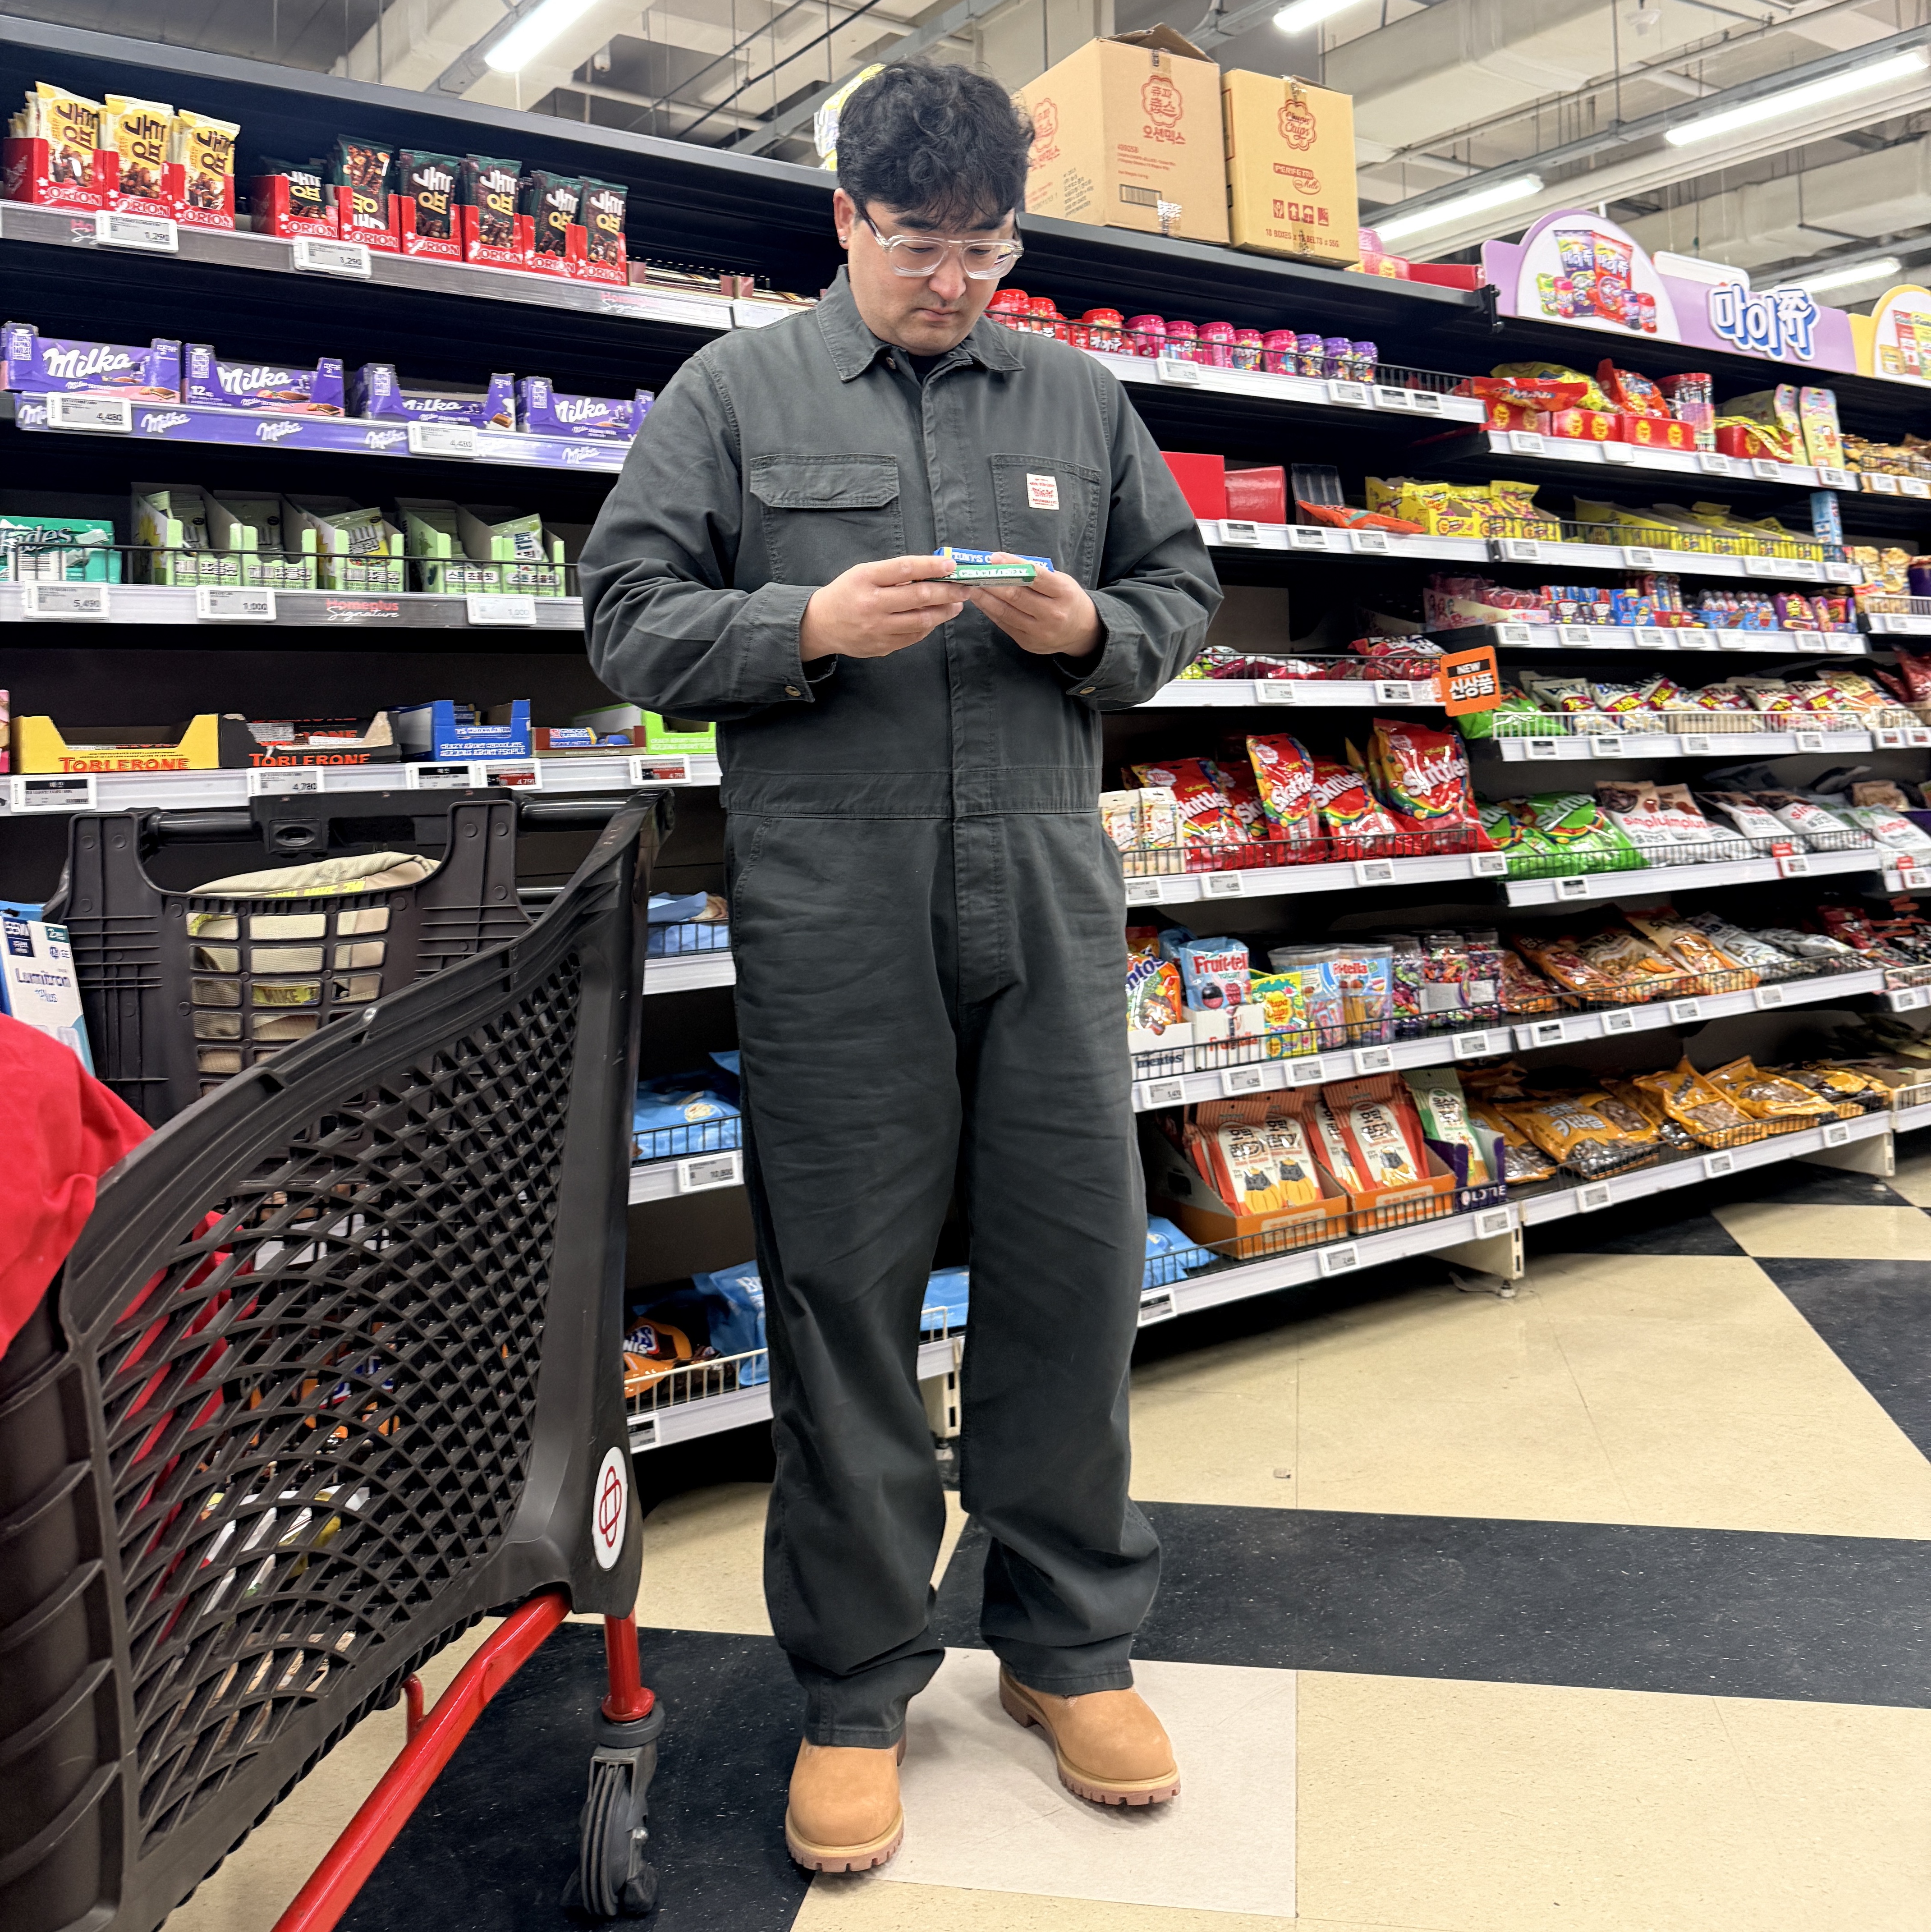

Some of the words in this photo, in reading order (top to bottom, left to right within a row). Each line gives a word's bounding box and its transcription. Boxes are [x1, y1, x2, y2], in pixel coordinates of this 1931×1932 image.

[48, 186, 103, 206] ORION
[116, 197, 170, 217] ORION
[183, 209, 234, 228] ORION
[289, 220, 338, 238] ORION
[351, 230, 399, 248] ORION
[414, 239, 460, 256] ORION
[478, 248, 522, 264] ORION
[533, 257, 576, 273] ORION
[585, 265, 626, 282] ORION
[1711, 283, 1817, 359] 마이쮸
[43, 346, 135, 378] Milka
[217, 366, 292, 395] Milka
[555, 397, 611, 423] Milka
[326, 599, 399, 612] Homeplus
[327, 606, 400, 622] Signature
[1456, 661, 1481, 675] NEW
[1449, 673, 1495, 701] 신상품
[58, 757, 190, 772] TOBLERONE
[249, 753, 371, 766] TOBLERONE
[1403, 757, 1468, 797] Skittles
[1311, 771, 1364, 808] Skittles
[1125, 955, 1169, 992] ntos
